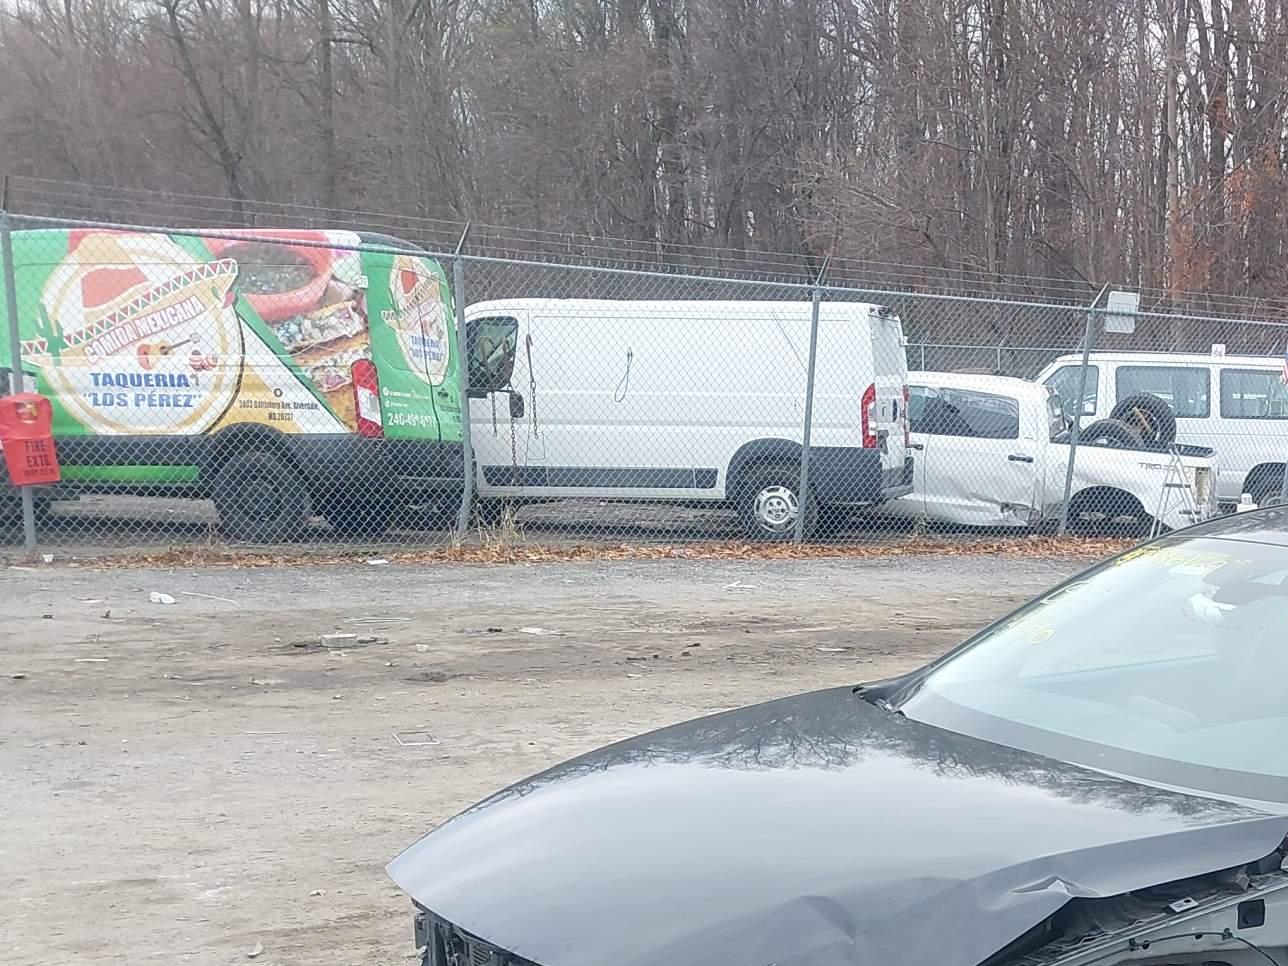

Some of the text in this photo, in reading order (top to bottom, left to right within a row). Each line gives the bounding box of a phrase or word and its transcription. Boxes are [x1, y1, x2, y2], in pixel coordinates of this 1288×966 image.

[84, 295, 206, 364] COMIDA MEXICANA
[25, 440, 47, 453] FIRE
